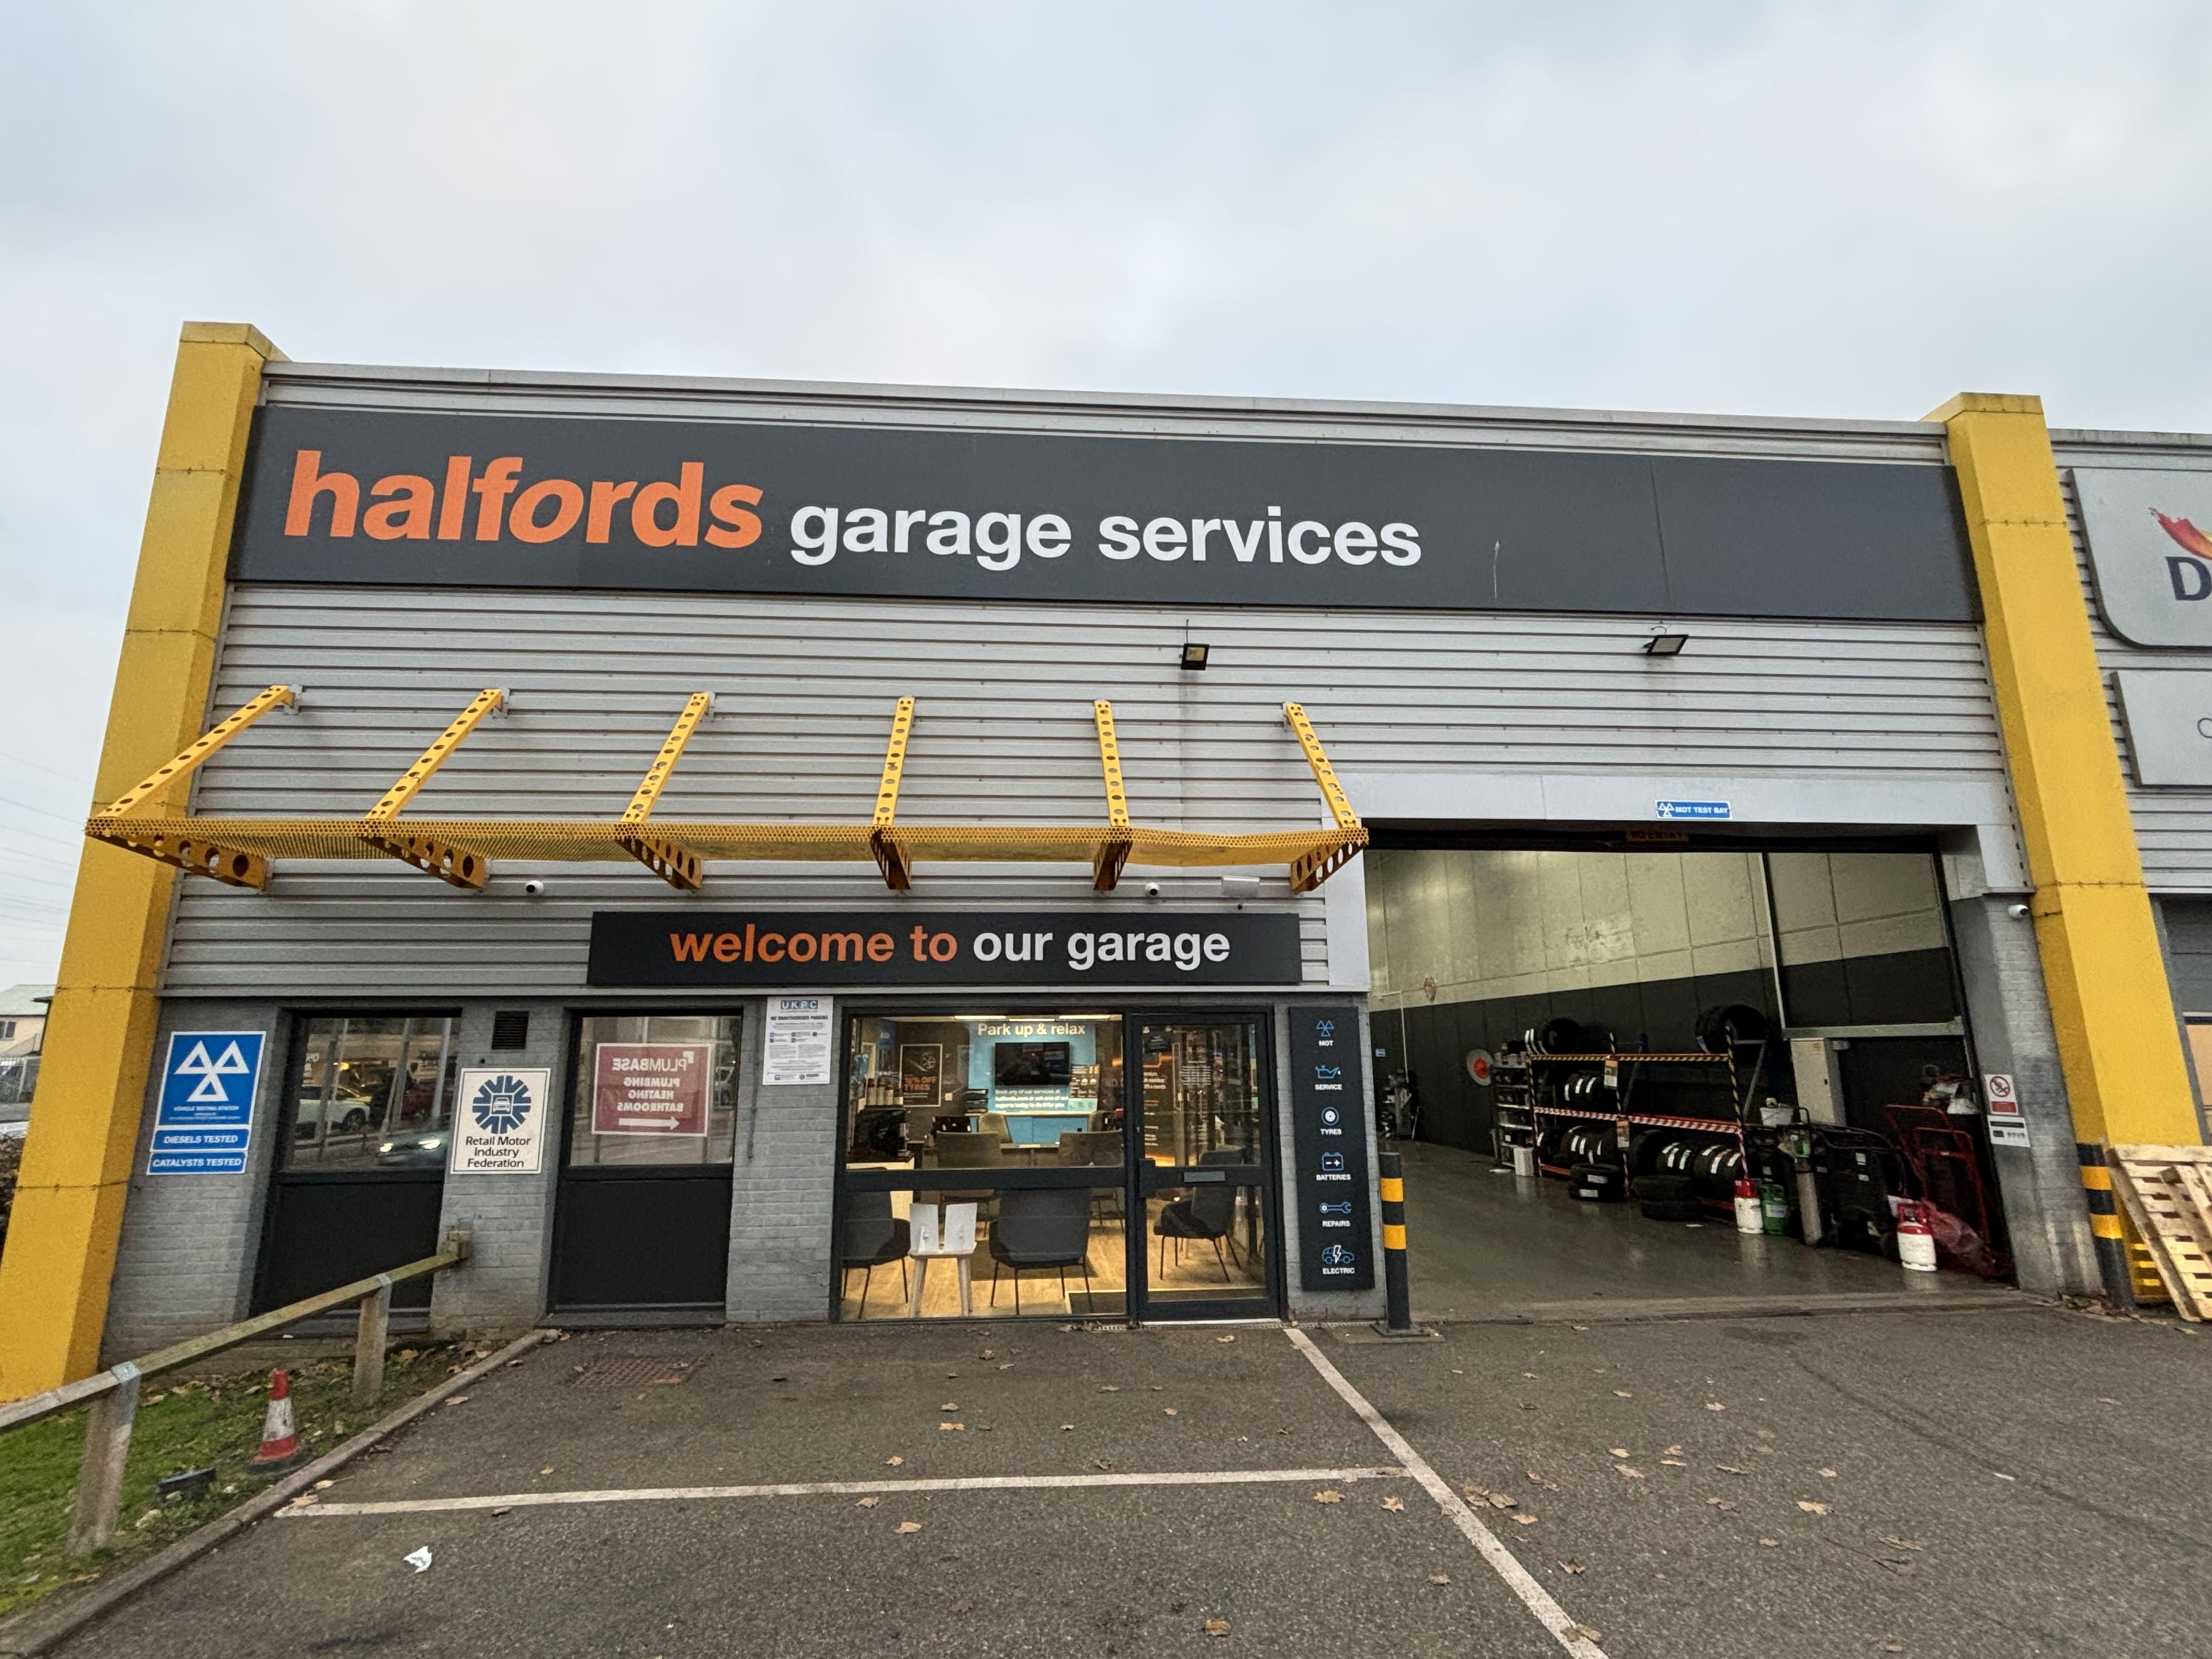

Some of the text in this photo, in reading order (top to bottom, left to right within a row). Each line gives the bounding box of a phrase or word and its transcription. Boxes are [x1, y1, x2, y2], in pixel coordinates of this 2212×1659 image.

[284, 450, 1421, 571] halfords garage services
[670, 923, 1230, 971] welcome to our garage
[782, 1001, 817, 1009] UKPC
[978, 1023, 1086, 1037] Park up & relax
[163, 1135, 239, 1144] DIESELS TESTED
[466, 1136, 531, 1146] Retail Motor
[474, 1147, 519, 1158] Industry
[153, 1159, 204, 1167] CATALYSTS
[467, 1158, 524, 1168] Federation
